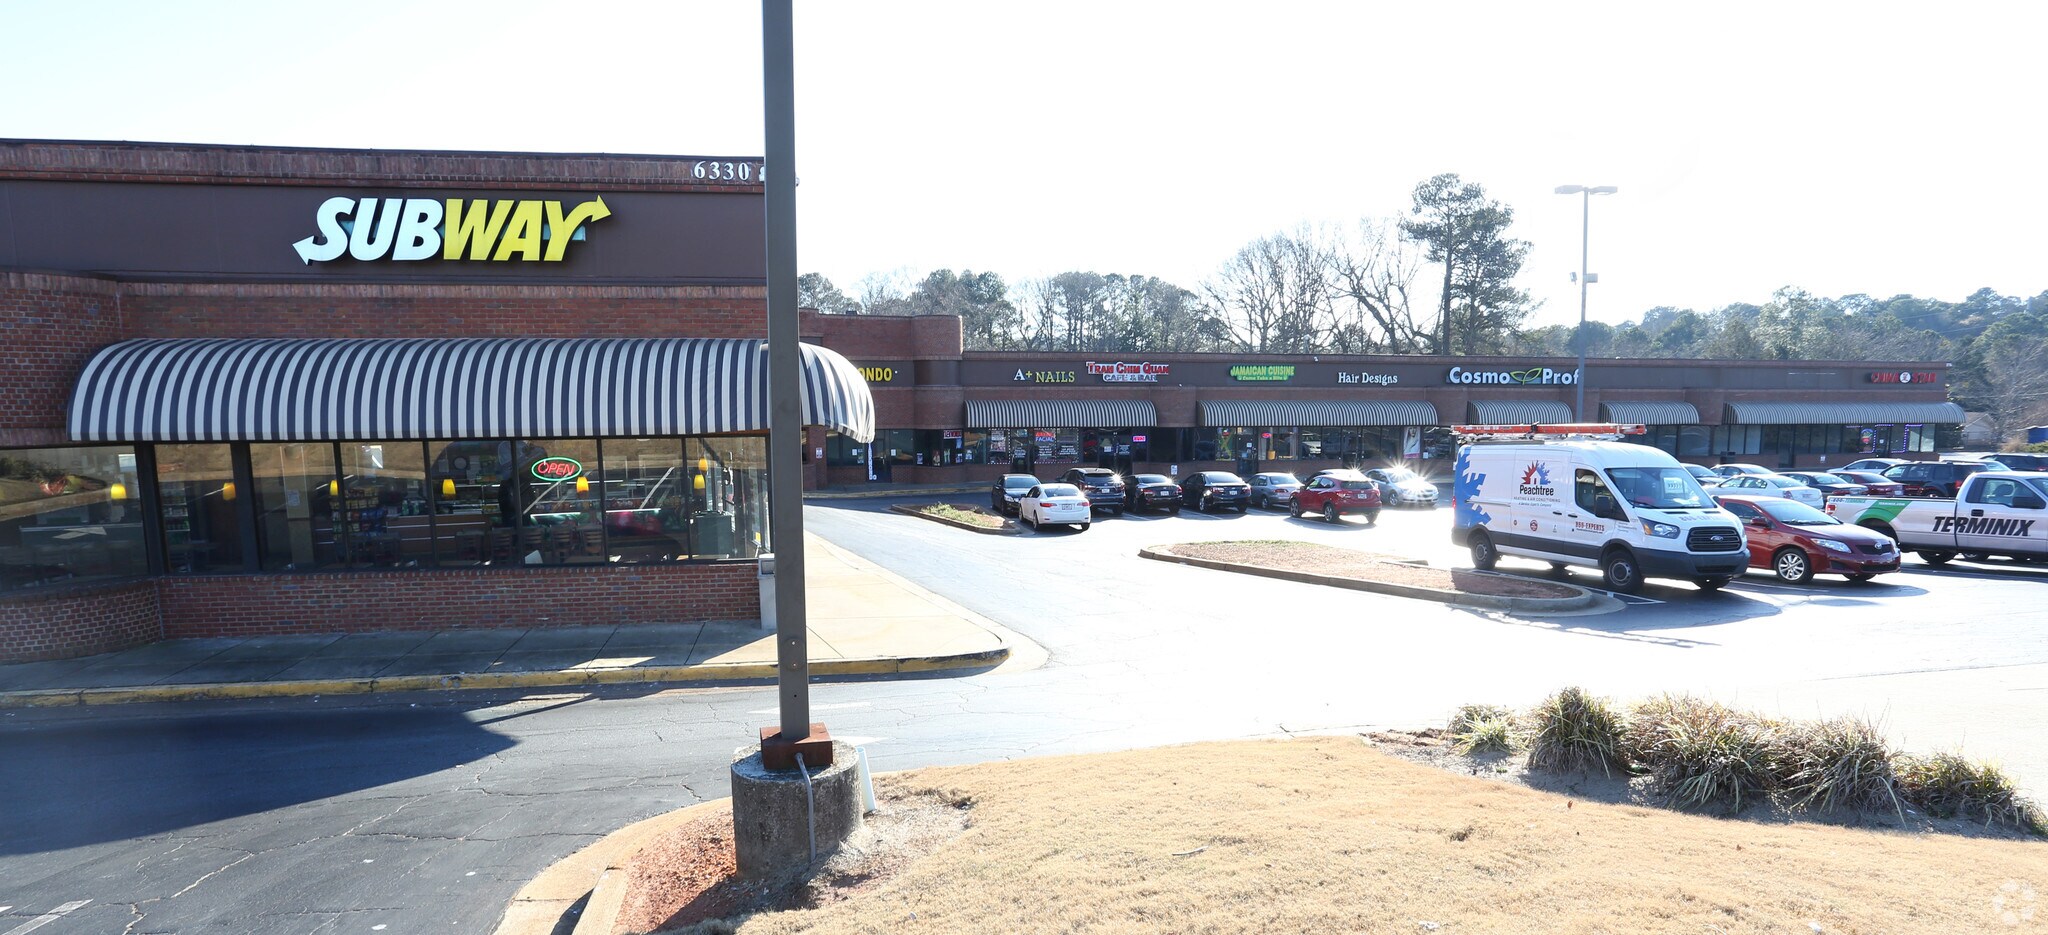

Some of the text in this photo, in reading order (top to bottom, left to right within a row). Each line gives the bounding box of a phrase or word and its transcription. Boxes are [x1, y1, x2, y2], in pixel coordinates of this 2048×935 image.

[694, 161, 750, 180] 6330
[292, 195, 612, 265] SUBWAY
[1013, 368, 1075, 383] A+ NAILS
[1230, 365, 1295, 376] JAMAICAN CUISINE
[1449, 366, 1579, 384] Cosmo Prof
[1912, 372, 1937, 383] STAR
[1337, 372, 1398, 386] Hair Designs
[537, 462, 576, 476] OPEN
[1520, 485, 1554, 496] Peachtree
[1933, 516, 2035, 537] TERMINIX
